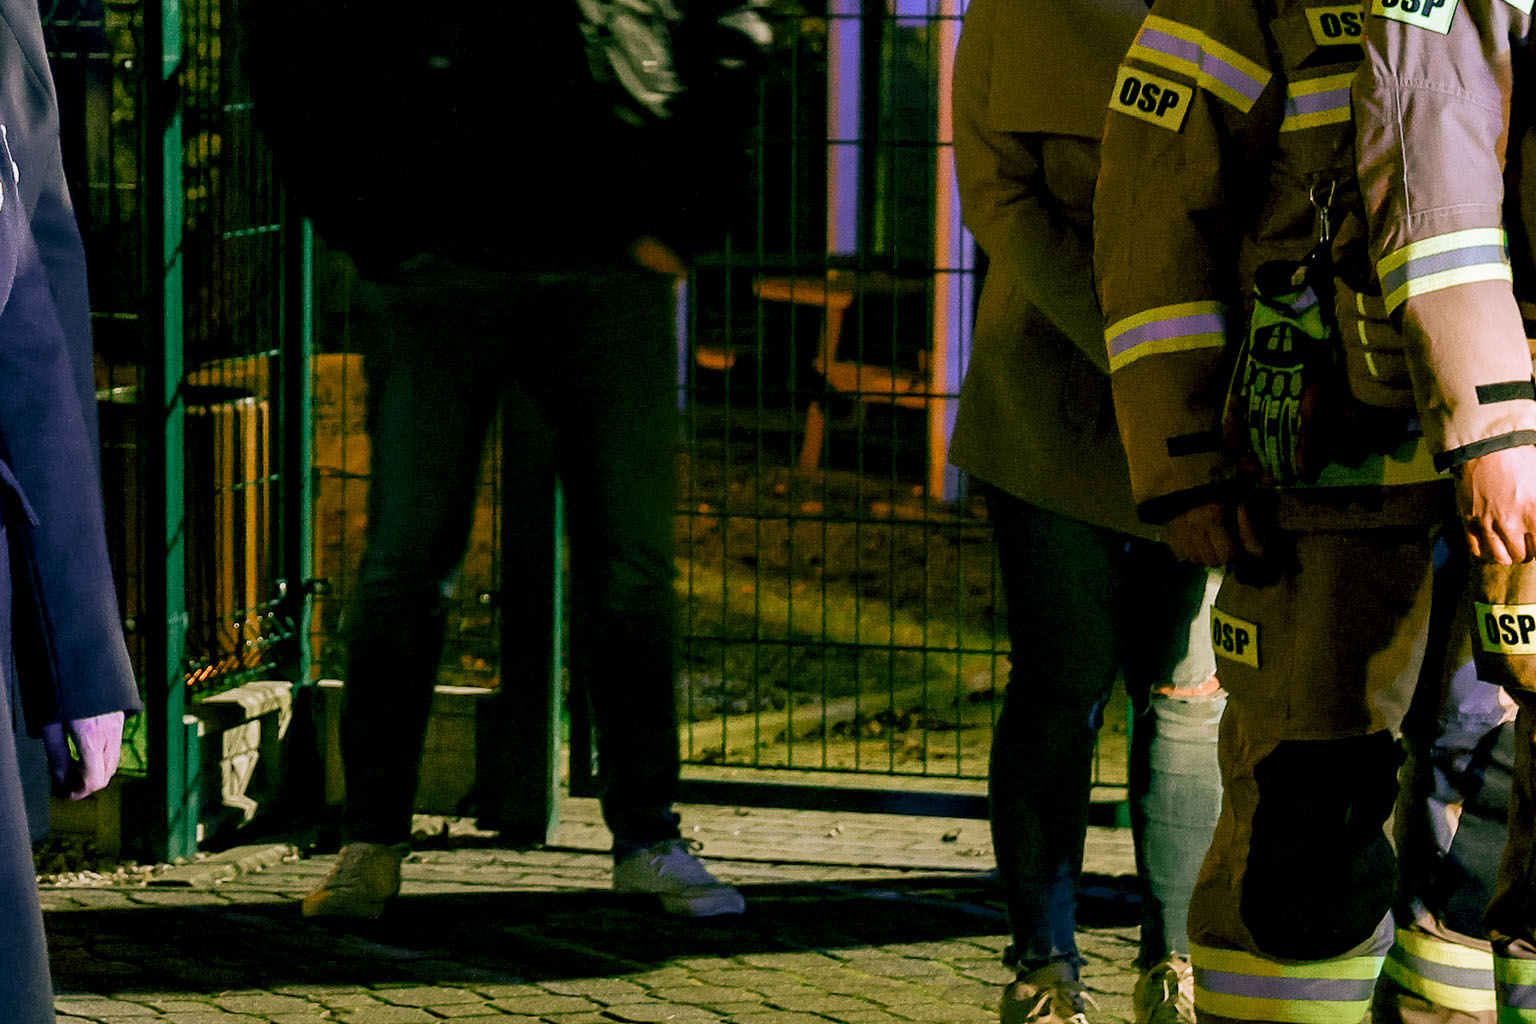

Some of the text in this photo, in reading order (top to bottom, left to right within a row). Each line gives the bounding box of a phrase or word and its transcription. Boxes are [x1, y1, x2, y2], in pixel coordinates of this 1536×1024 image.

[1320, 12, 1365, 38] OS
[1119, 76, 1180, 118] OSP
[1214, 617, 1250, 655] OSP
[1484, 613, 1536, 645] OSP
